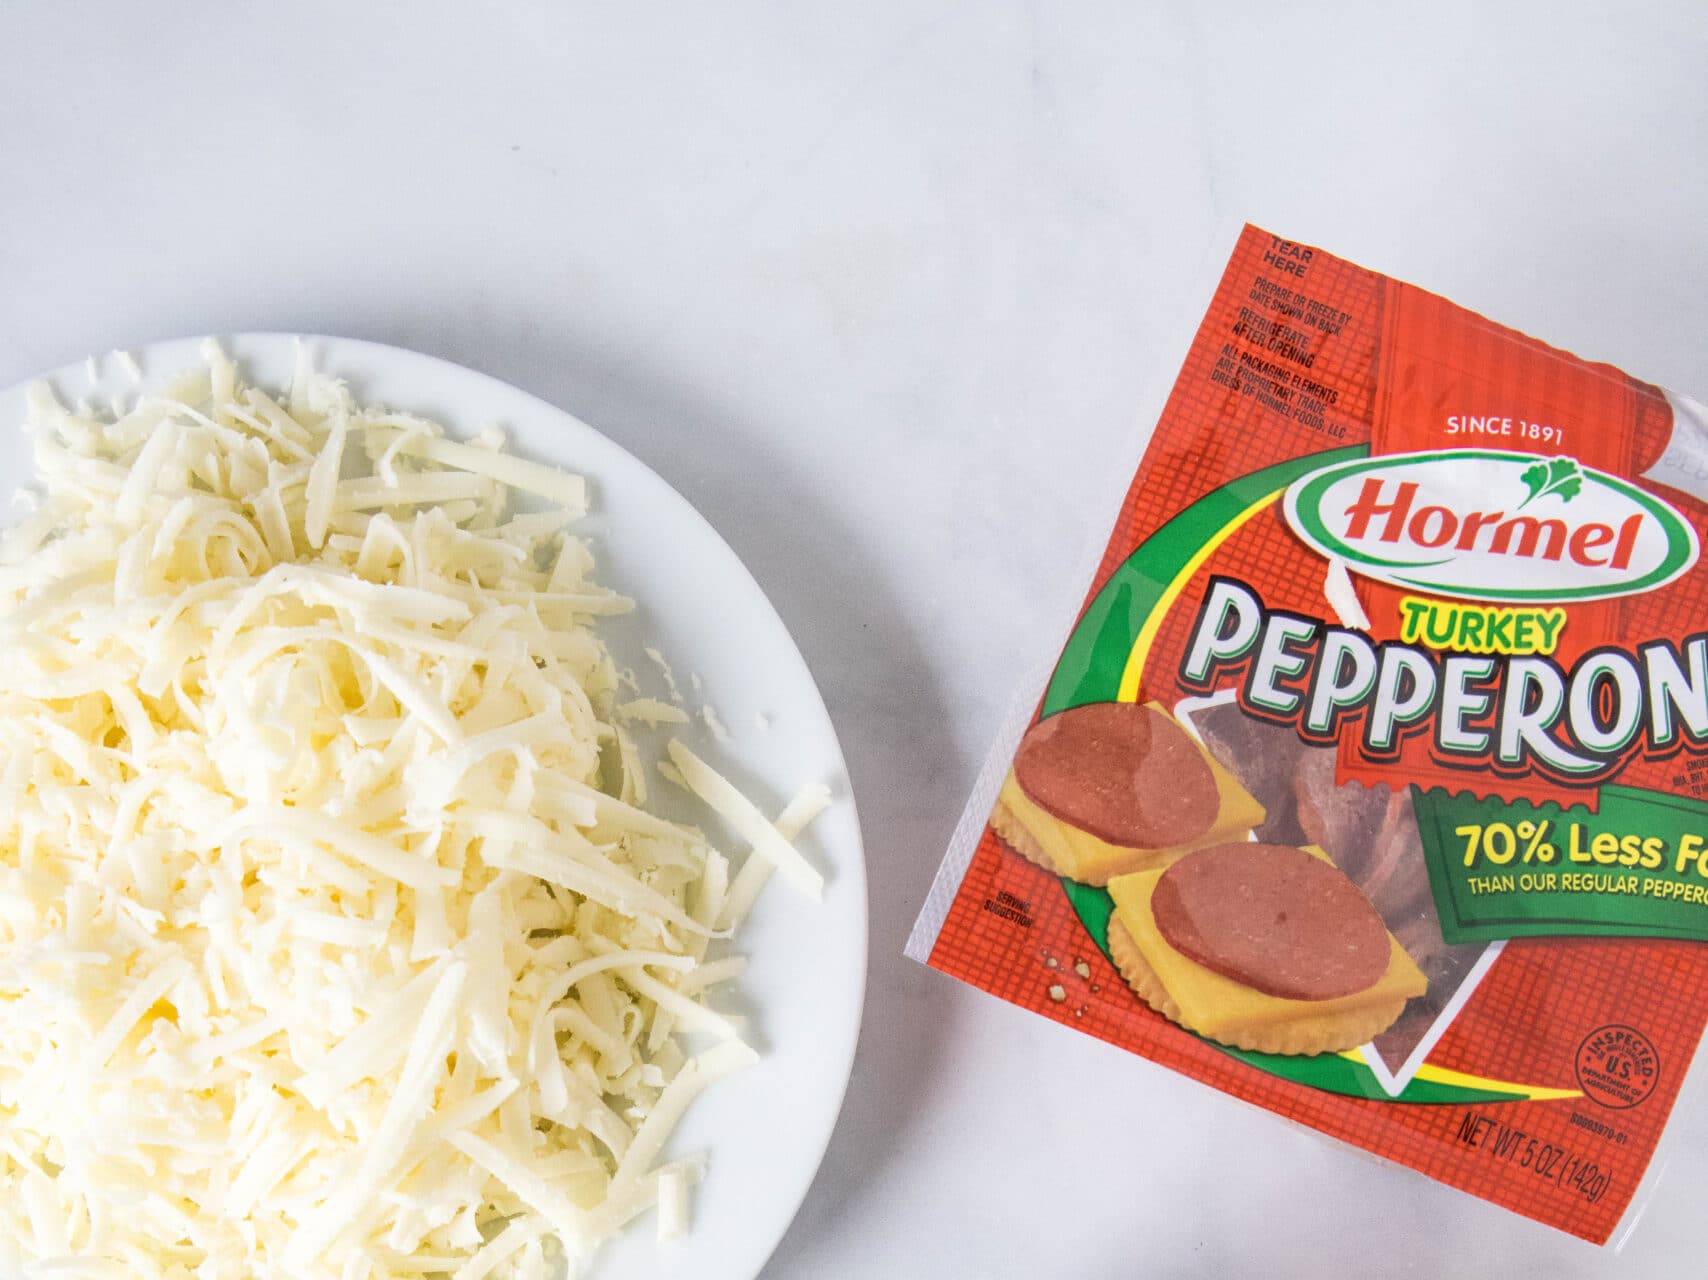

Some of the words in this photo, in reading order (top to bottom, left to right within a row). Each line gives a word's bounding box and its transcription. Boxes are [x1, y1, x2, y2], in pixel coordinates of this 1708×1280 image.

[1263, 253, 1308, 278] HERE
[1271, 235, 1313, 263] TEAR
[1249, 289, 1270, 307] DATE
[1270, 298, 1303, 320] SHOWN
[1303, 312, 1318, 325] ON
[1318, 318, 1342, 337] BACK
[1253, 276, 1293, 302] PREPARE
[1293, 292, 1306, 306] OR
[1307, 297, 1337, 321] FREEZE
[1339, 312, 1352, 326] BY
[1232, 321, 1266, 348] AFTER
[1267, 335, 1316, 369] OPENING
[1239, 307, 1310, 349] REFRIGERATE
[1216, 357, 1235, 374] ARE
[1235, 365, 1297, 403] PROPRIETARY
[1299, 393, 1328, 416] TRADE
[1220, 343, 1238, 361] ALL
[1240, 353, 1291, 386] PACKAGING
[1292, 375, 1339, 405] ELEMENTS
[1210, 370, 1242, 391] DRESS
[1241, 382, 1254, 396] OF
[1255, 391, 1292, 419] HORMEL
[1328, 422, 1347, 440] LLC
[1446, 415, 1513, 436] SINCE
[1519, 419, 1564, 446] 1891
[1342, 476, 1645, 571] Hormel
[1402, 601, 1564, 650] TURKEY
[1455, 820, 1555, 868] 70%
[1569, 822, 1664, 869] Less
[996, 890, 1031, 914] SERVING
[1468, 876, 1515, 896] THAN
[1519, 873, 1557, 892] OUR
[1562, 872, 1639, 895] REGULAR
[983, 899, 1033, 928] SUGGESTION
[1587, 1031, 1653, 1078] INSPECTED
[1581, 1066, 1631, 1092] DEPARTMENT
[1457, 1111, 1498, 1147] NET
[1492, 1125, 1526, 1162] WT
[1520, 1138, 1538, 1169] 5
[1534, 1144, 1565, 1179] OZ
[1557, 1153, 1613, 1204] (142g)
